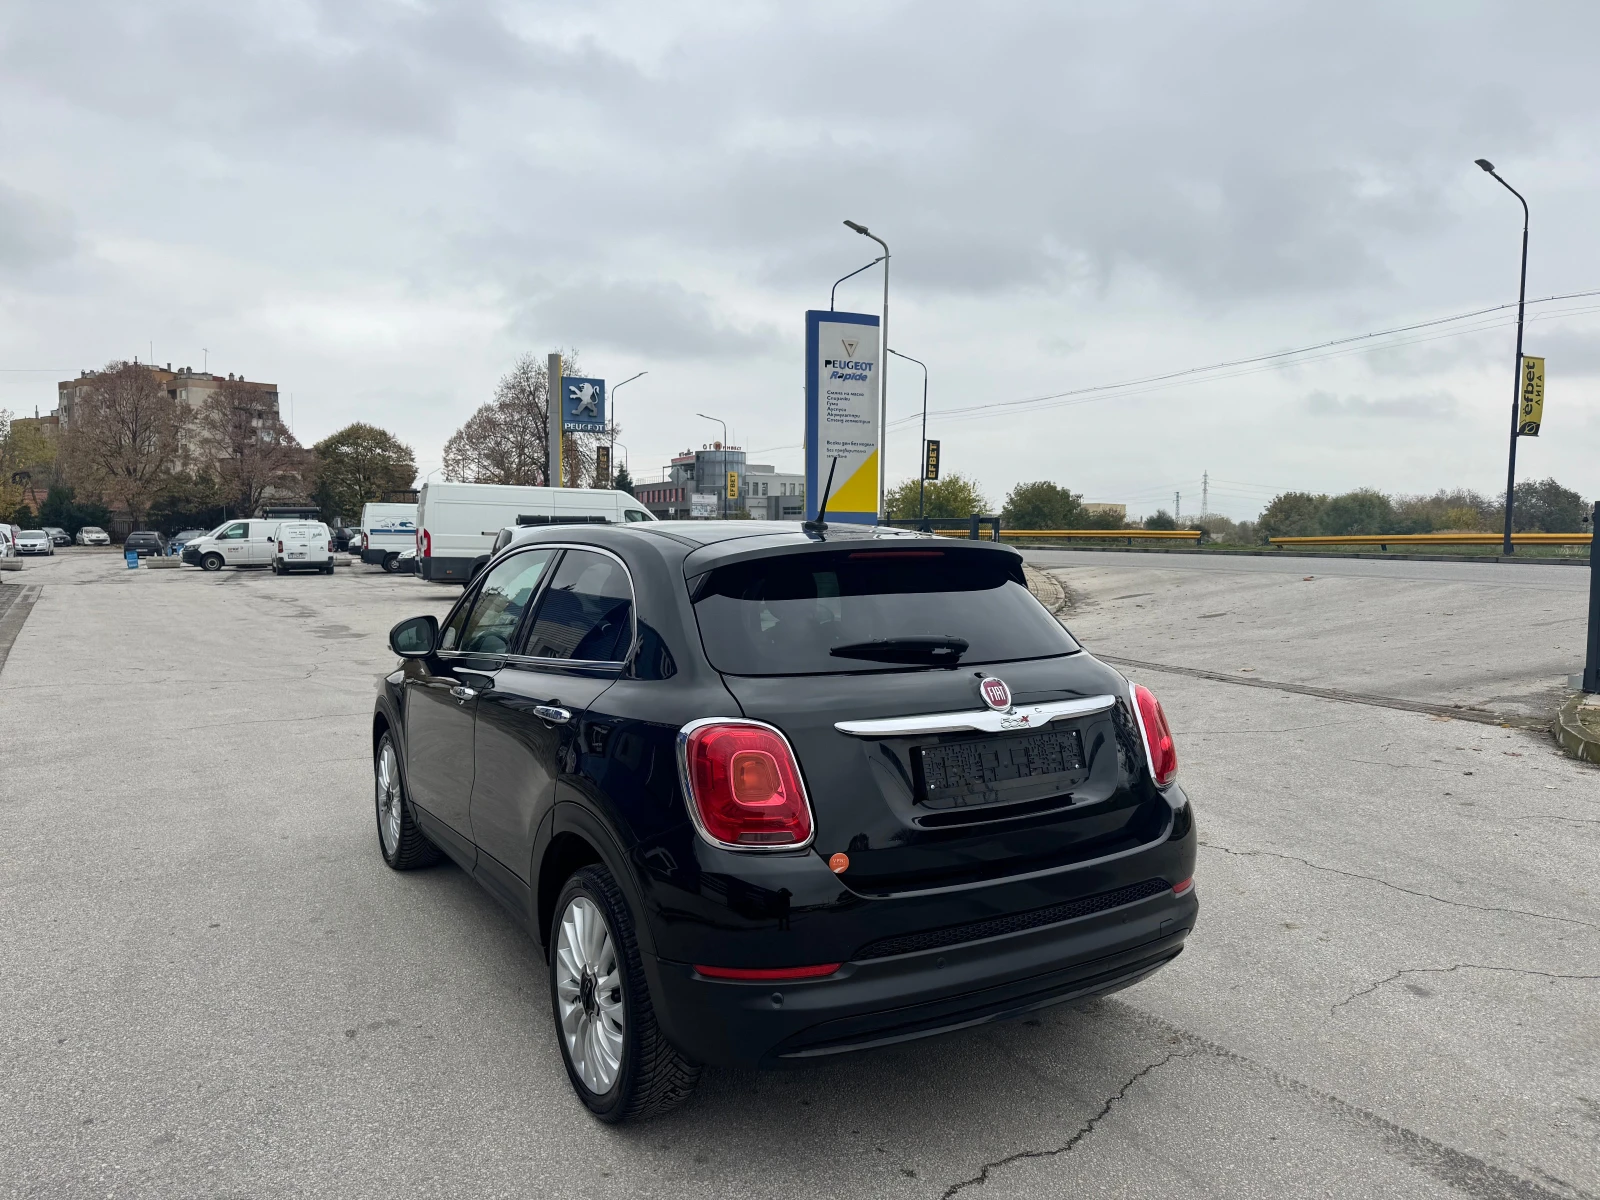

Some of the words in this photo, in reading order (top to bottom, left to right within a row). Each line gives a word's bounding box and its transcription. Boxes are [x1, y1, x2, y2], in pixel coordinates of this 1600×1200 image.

[825, 360, 873, 371] PEUGEOT
[830, 370, 868, 381] Rapide
[1523, 361, 1536, 416] efbet
[1535, 374, 1543, 406] ЛИГА
[564, 422, 604, 431] PEUGEOT
[929, 443, 937, 478] EFBET
[987, 686, 1006, 702] FIAT
